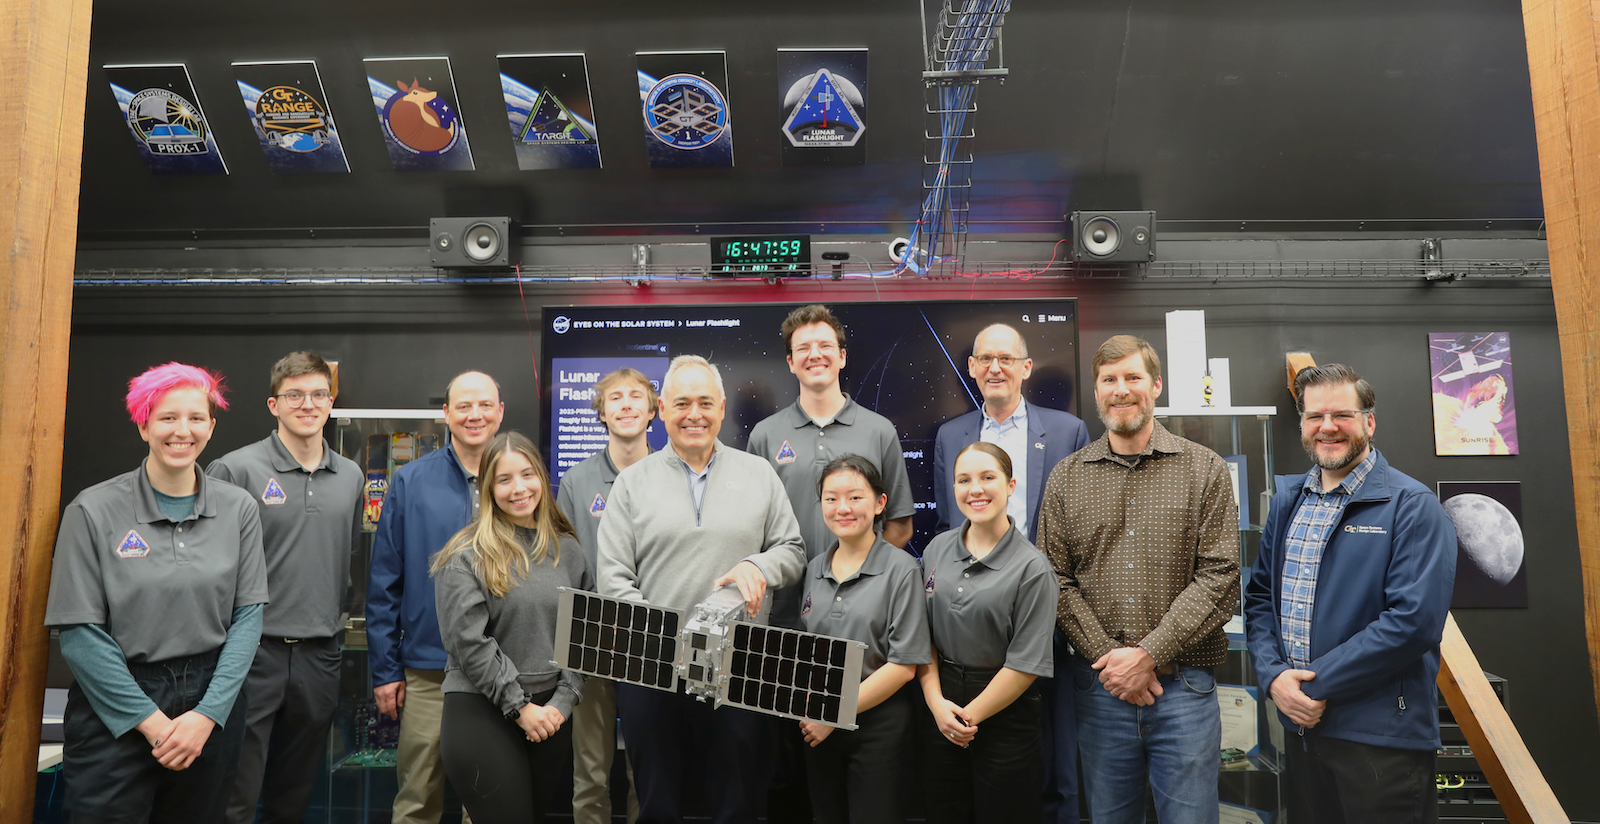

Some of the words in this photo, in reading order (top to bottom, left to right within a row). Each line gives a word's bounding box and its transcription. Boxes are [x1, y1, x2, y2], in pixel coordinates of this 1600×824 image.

[272, 89, 293, 102] GT
[261, 102, 315, 113] RANGE
[686, 131, 691, 140] 1
[158, 144, 200, 153] PROX-1
[725, 240, 800, 257] 16:47:59
[706, 319, 740, 327] Flashlight
[560, 370, 600, 383] Lunar
[560, 388, 597, 400] Flash
[903, 450, 923, 459] shlight
[1344, 525, 1356, 533] GT
